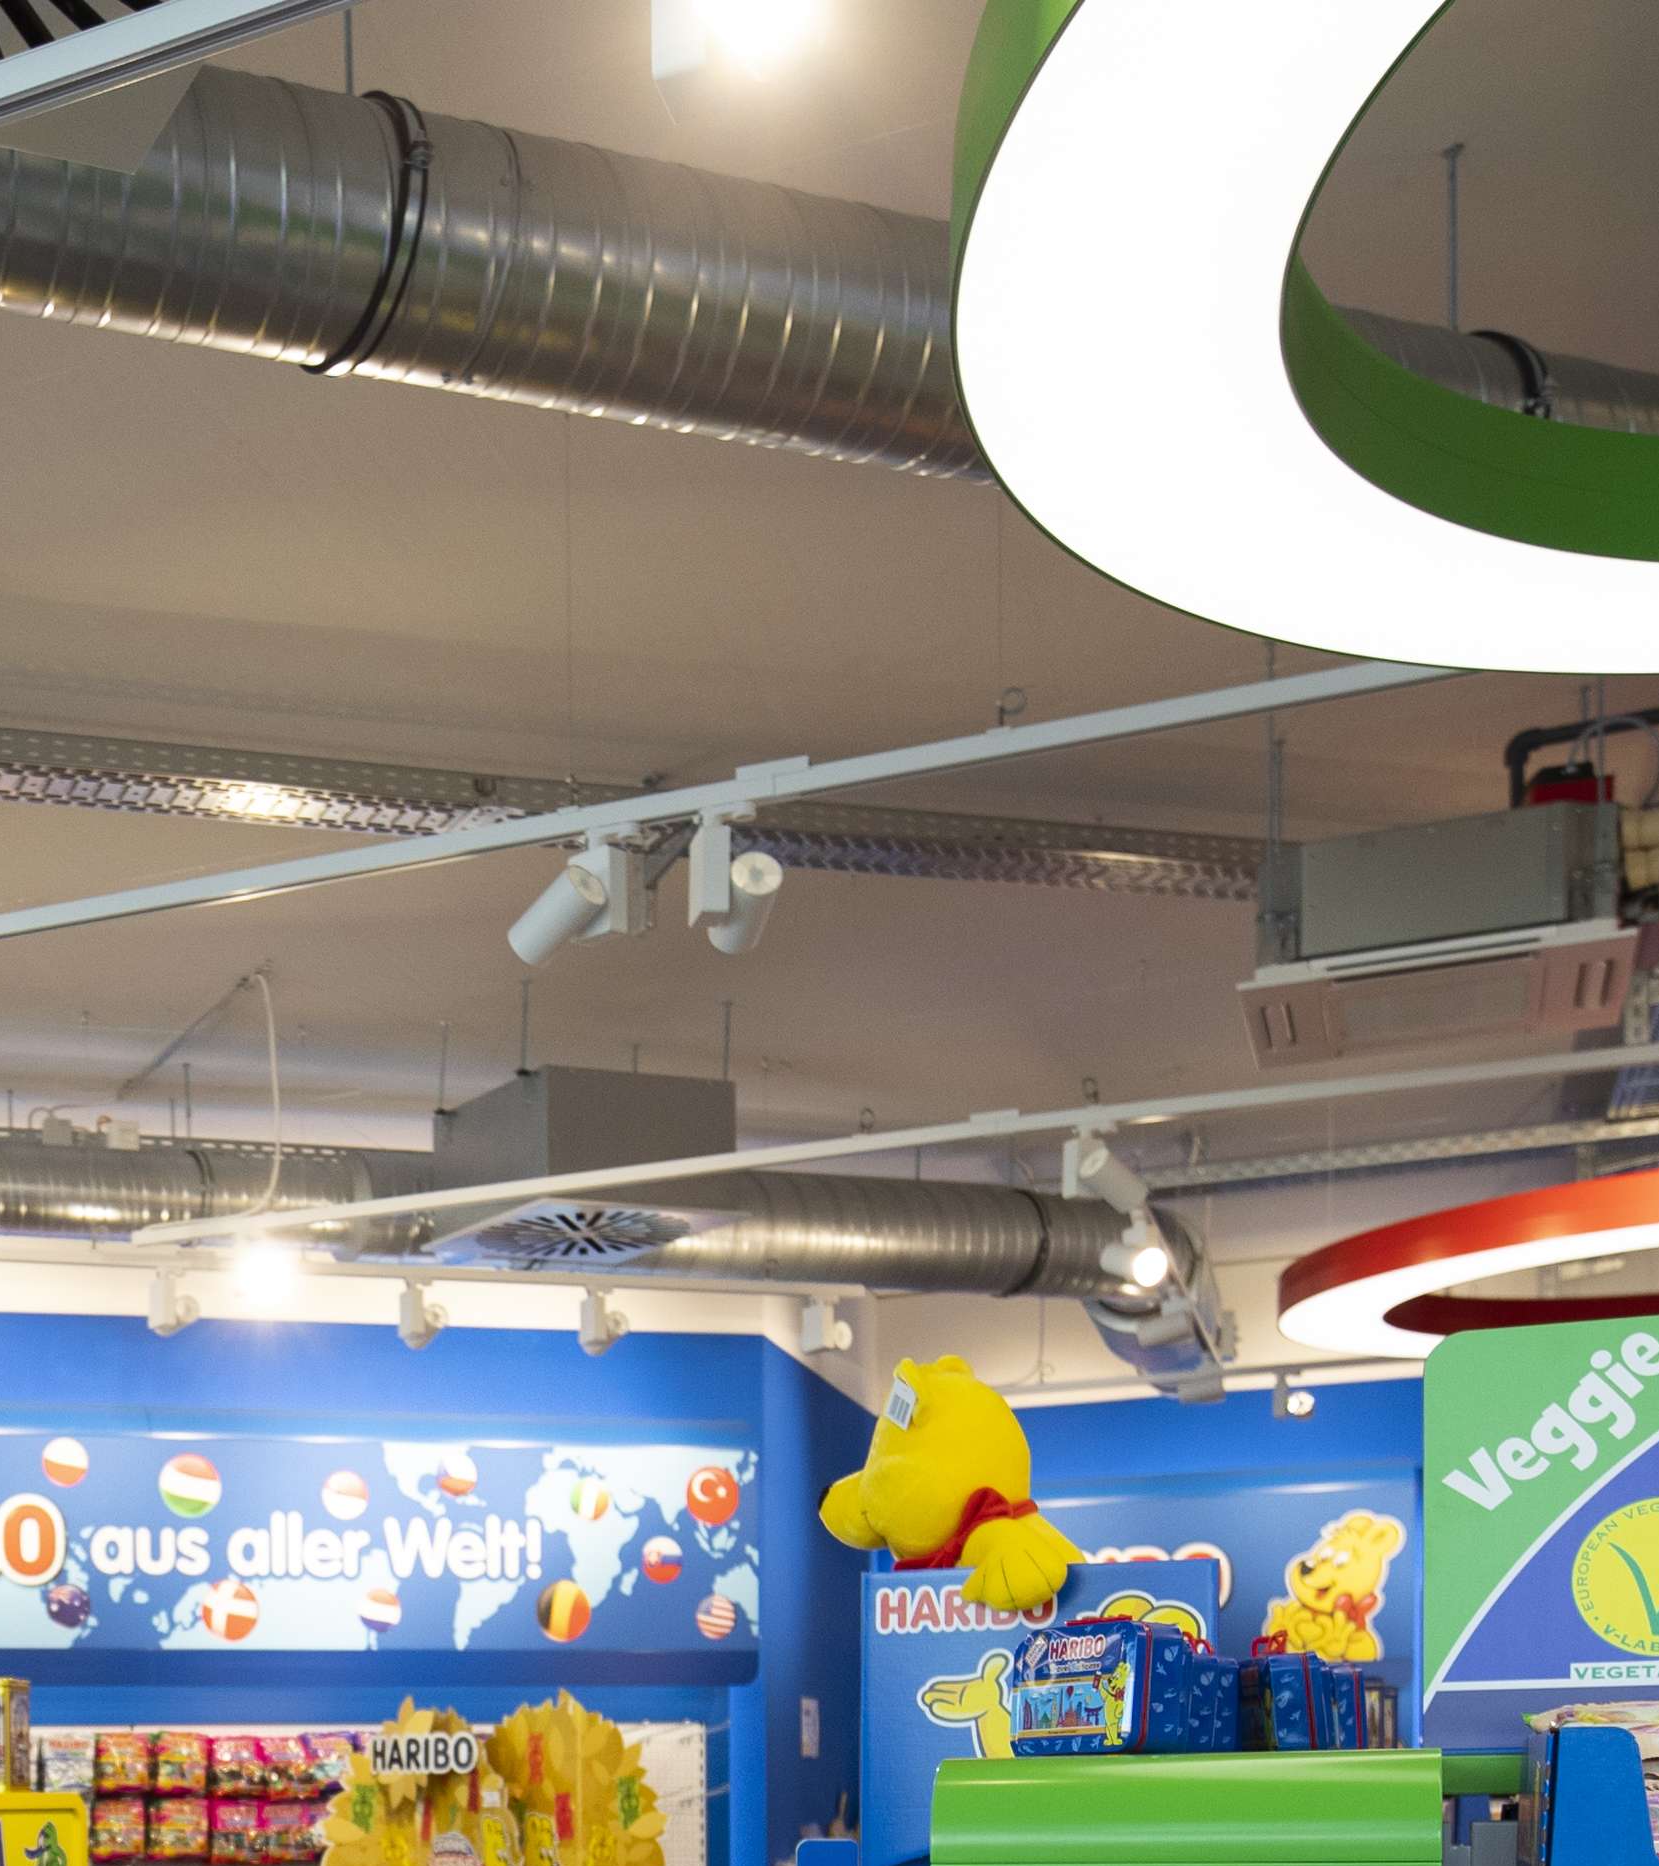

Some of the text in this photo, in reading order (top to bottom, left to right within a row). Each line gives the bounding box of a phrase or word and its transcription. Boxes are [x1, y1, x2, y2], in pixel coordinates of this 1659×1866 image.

[89, 1516, 209, 1577] aus
[227, 1512, 370, 1578] aller
[385, 1515, 544, 1580] Welt!
[1577, 1519, 1619, 1612] EUROPEAN
[1050, 1635, 1105, 1660] HARIBO
[373, 1735, 475, 1771] HARIBO
